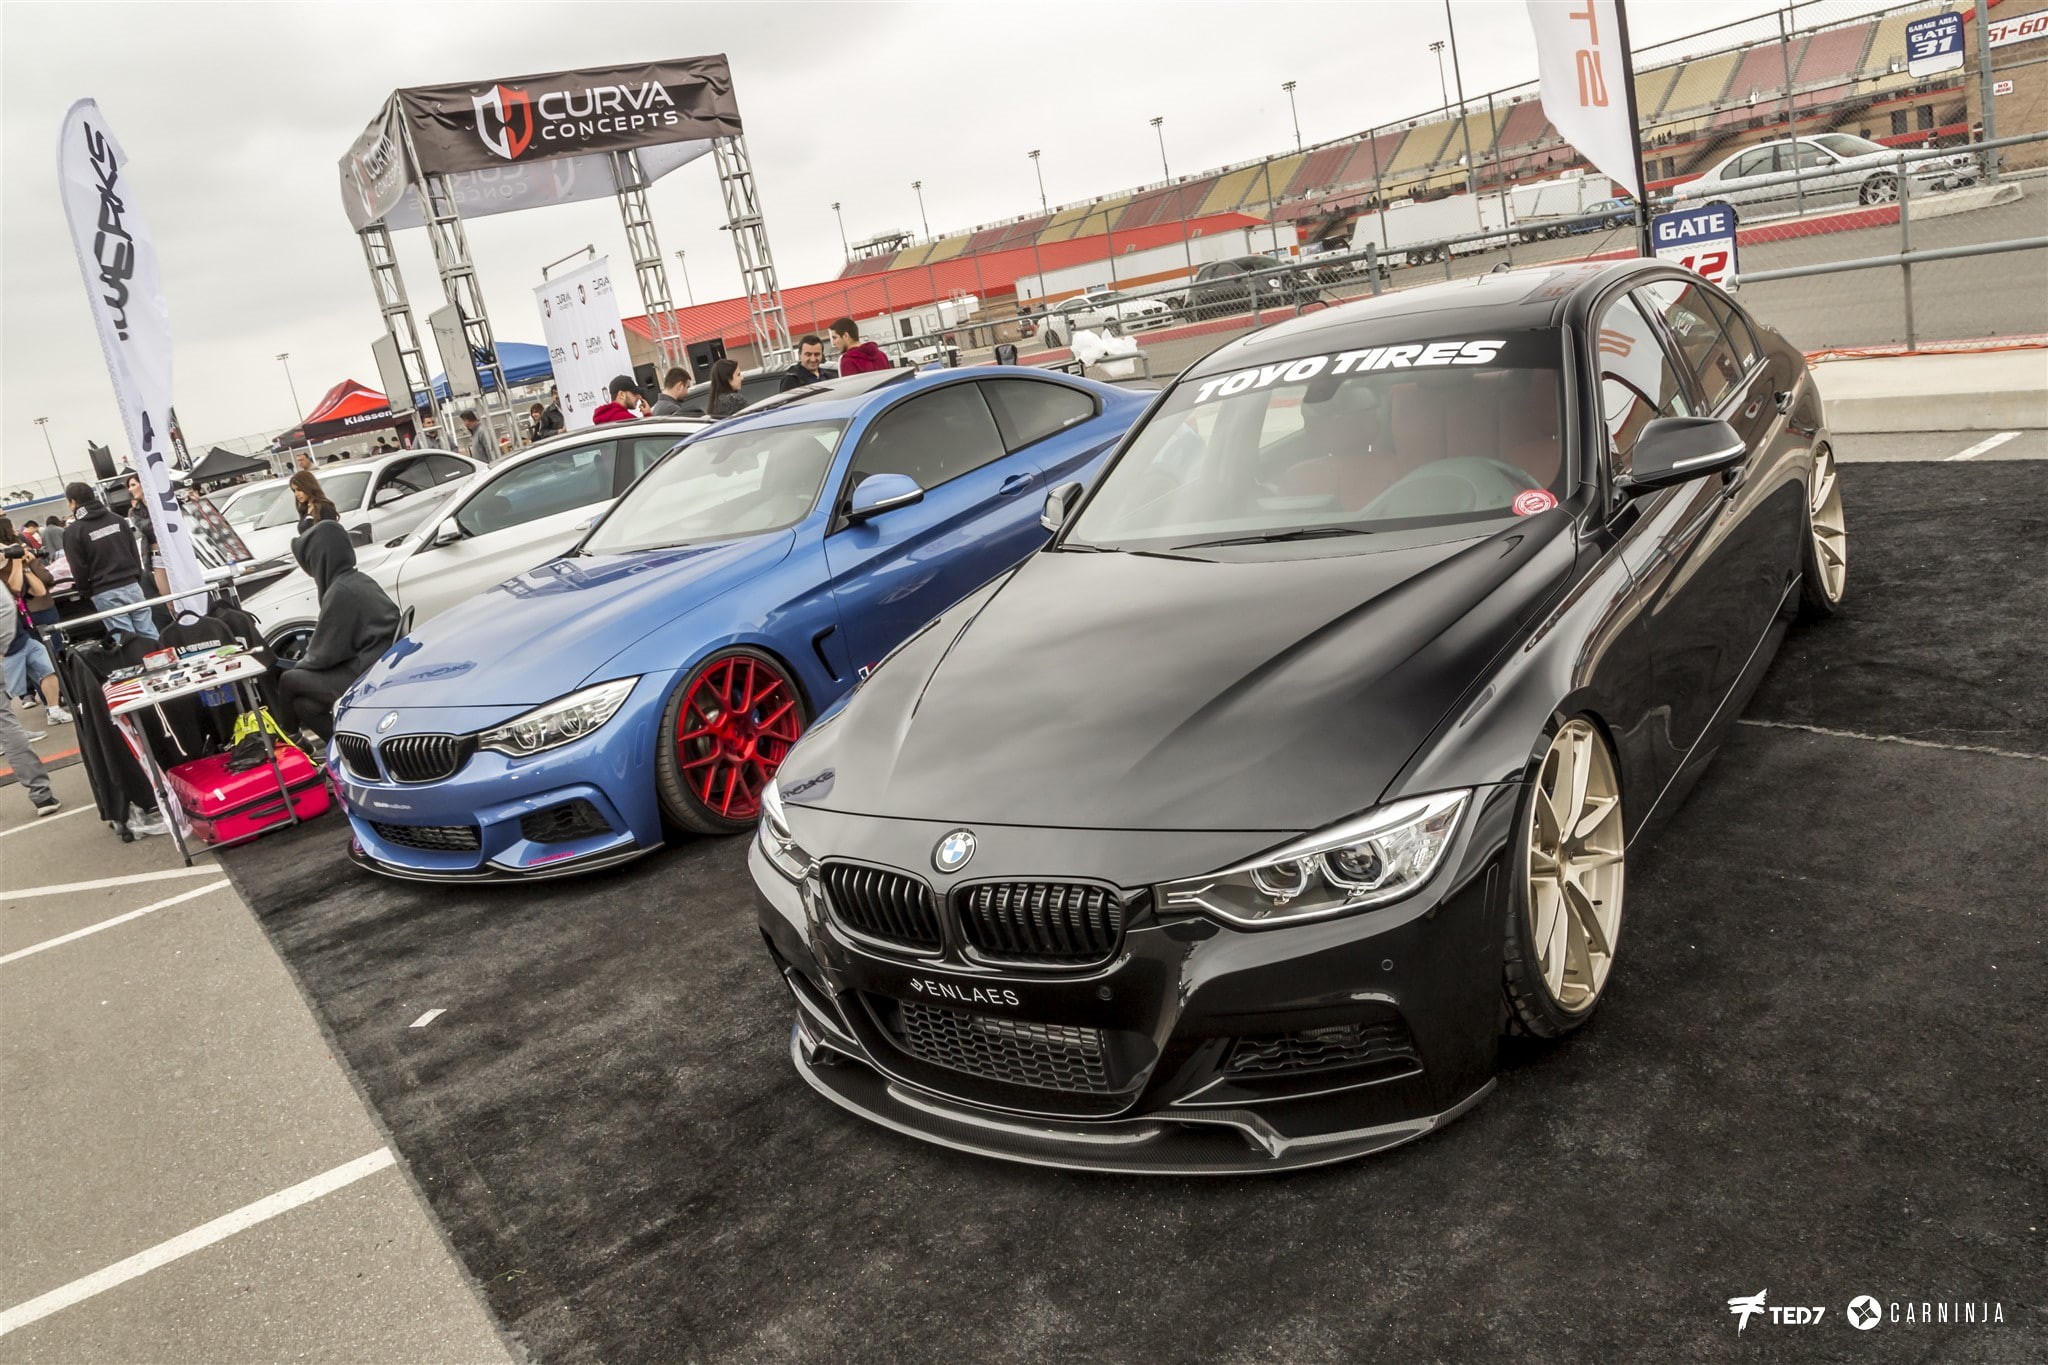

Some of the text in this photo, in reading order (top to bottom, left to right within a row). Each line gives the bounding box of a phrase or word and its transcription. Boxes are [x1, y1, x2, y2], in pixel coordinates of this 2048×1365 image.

[1908, 16, 1958, 33] GARAGE AREA
[1911, 25, 1957, 42] GATE
[1912, 35, 1953, 59] 31
[538, 81, 675, 121] CURVA
[541, 110, 679, 141] CONCEPTS
[1659, 213, 1726, 241] GATE
[1193, 340, 1507, 404] TOYO TIRES
